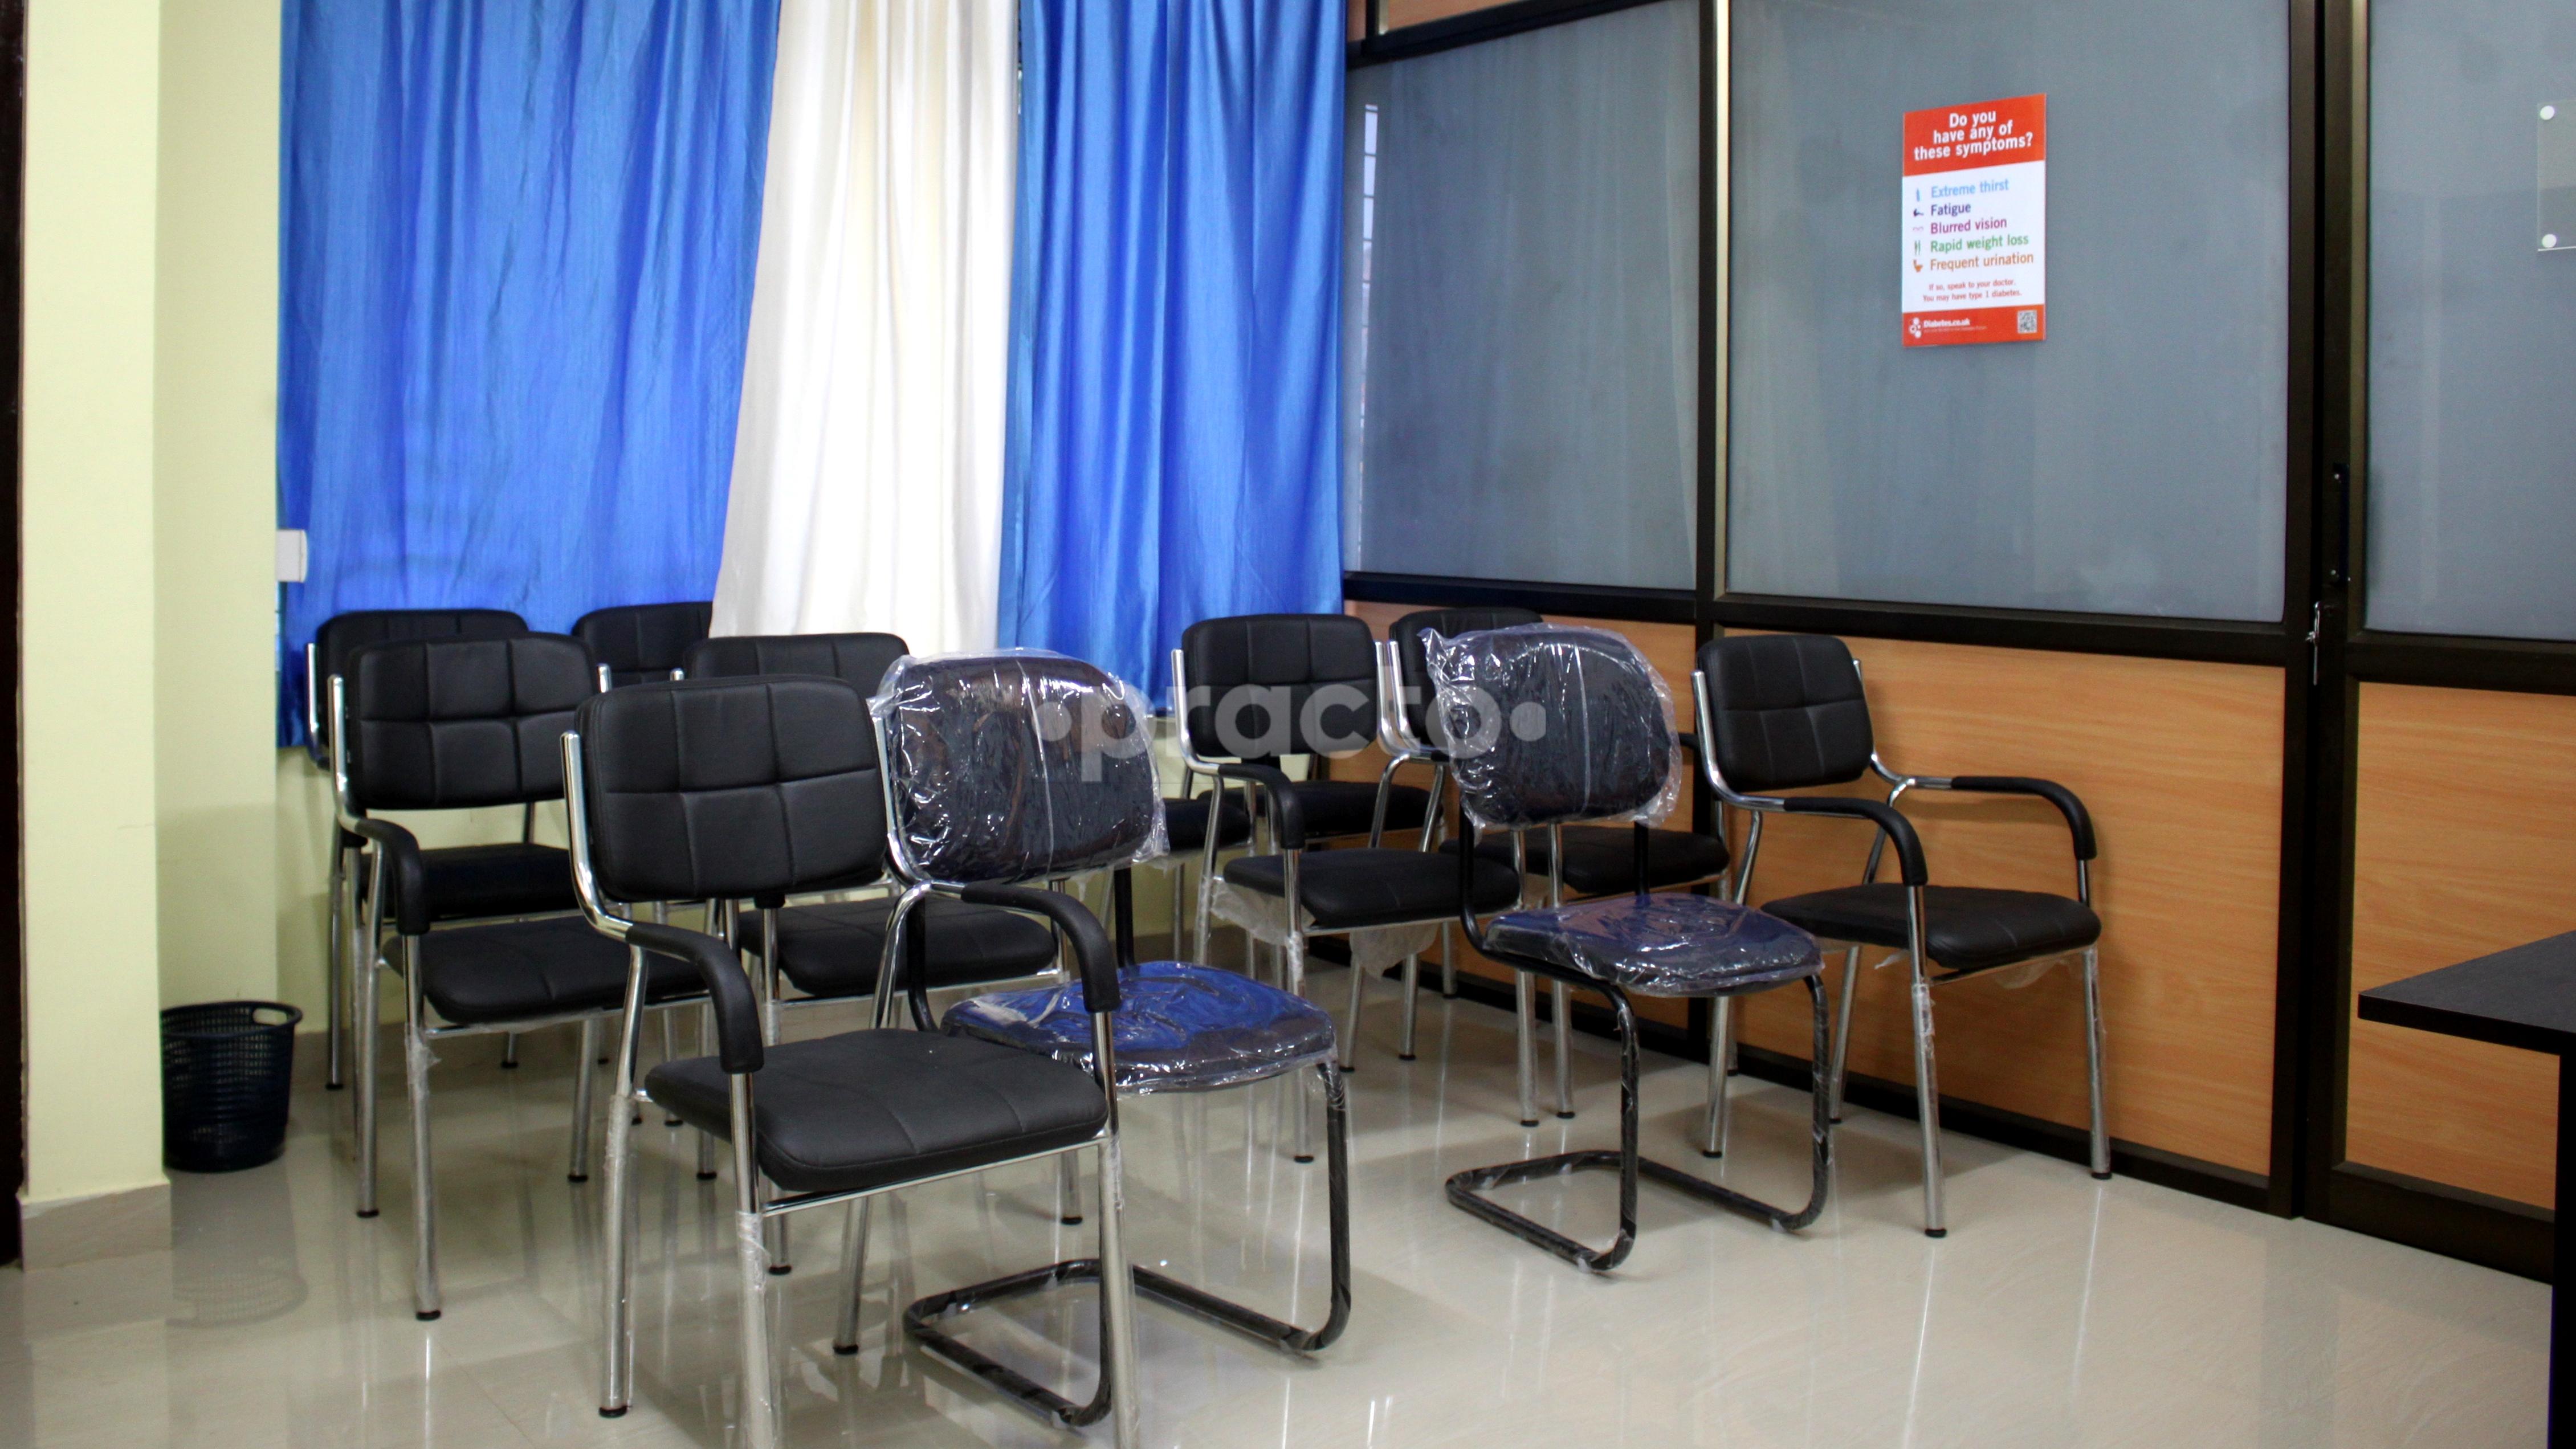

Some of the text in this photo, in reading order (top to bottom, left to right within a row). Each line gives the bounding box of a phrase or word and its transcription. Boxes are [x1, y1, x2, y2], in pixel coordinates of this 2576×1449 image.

[1949, 111, 1996, 128] Do you
[1933, 120, 2013, 144] have any of
[1914, 132, 2033, 161] these symptoms?
[1931, 178, 2010, 198] Extreme thirst
[1931, 203, 1971, 217] Fatigue
[1930, 218, 2007, 234] Blurred vision
[1930, 234, 2029, 254] Rapid weight loss
[1930, 252, 2033, 272] Frequent urination
